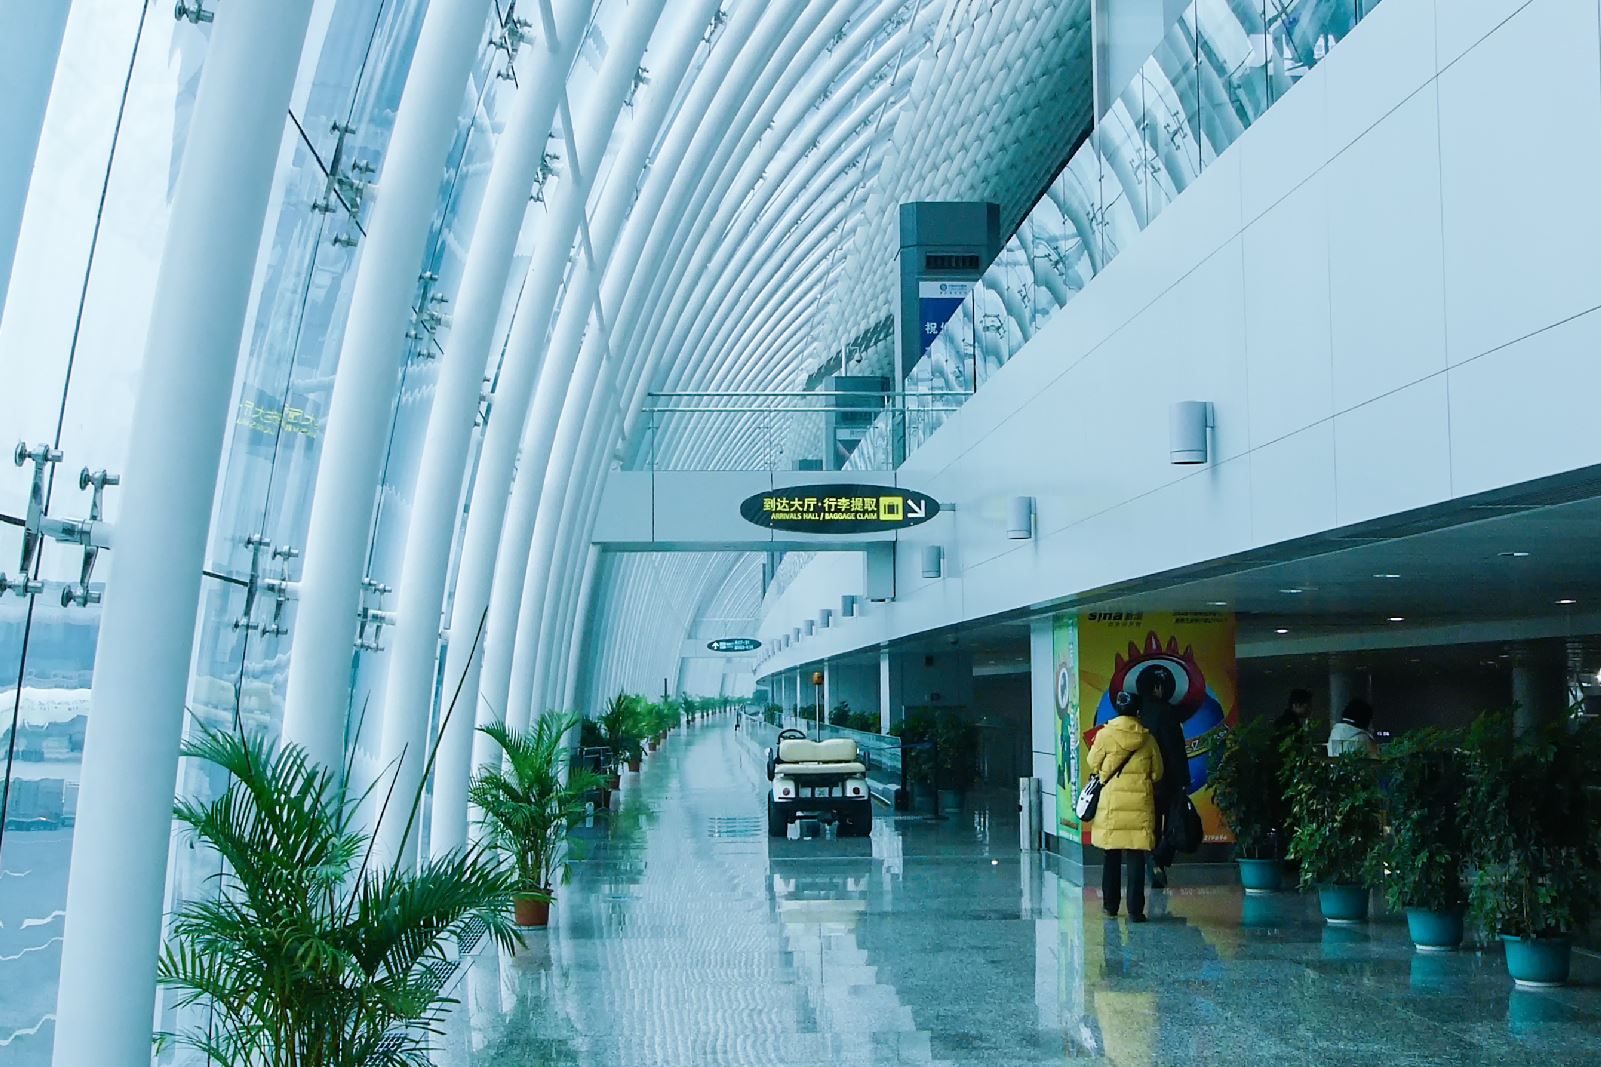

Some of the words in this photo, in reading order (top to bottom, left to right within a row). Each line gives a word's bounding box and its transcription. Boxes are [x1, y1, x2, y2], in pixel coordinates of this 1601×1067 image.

[763, 497, 877, 512] 到达大厅·行李提取
[771, 512, 802, 520] ARRIVALS
[803, 512, 819, 520] HALL
[825, 512, 856, 520] BAGGAGE
[856, 512, 878, 520] CLAIM
[1088, 611, 1123, 623] sina
